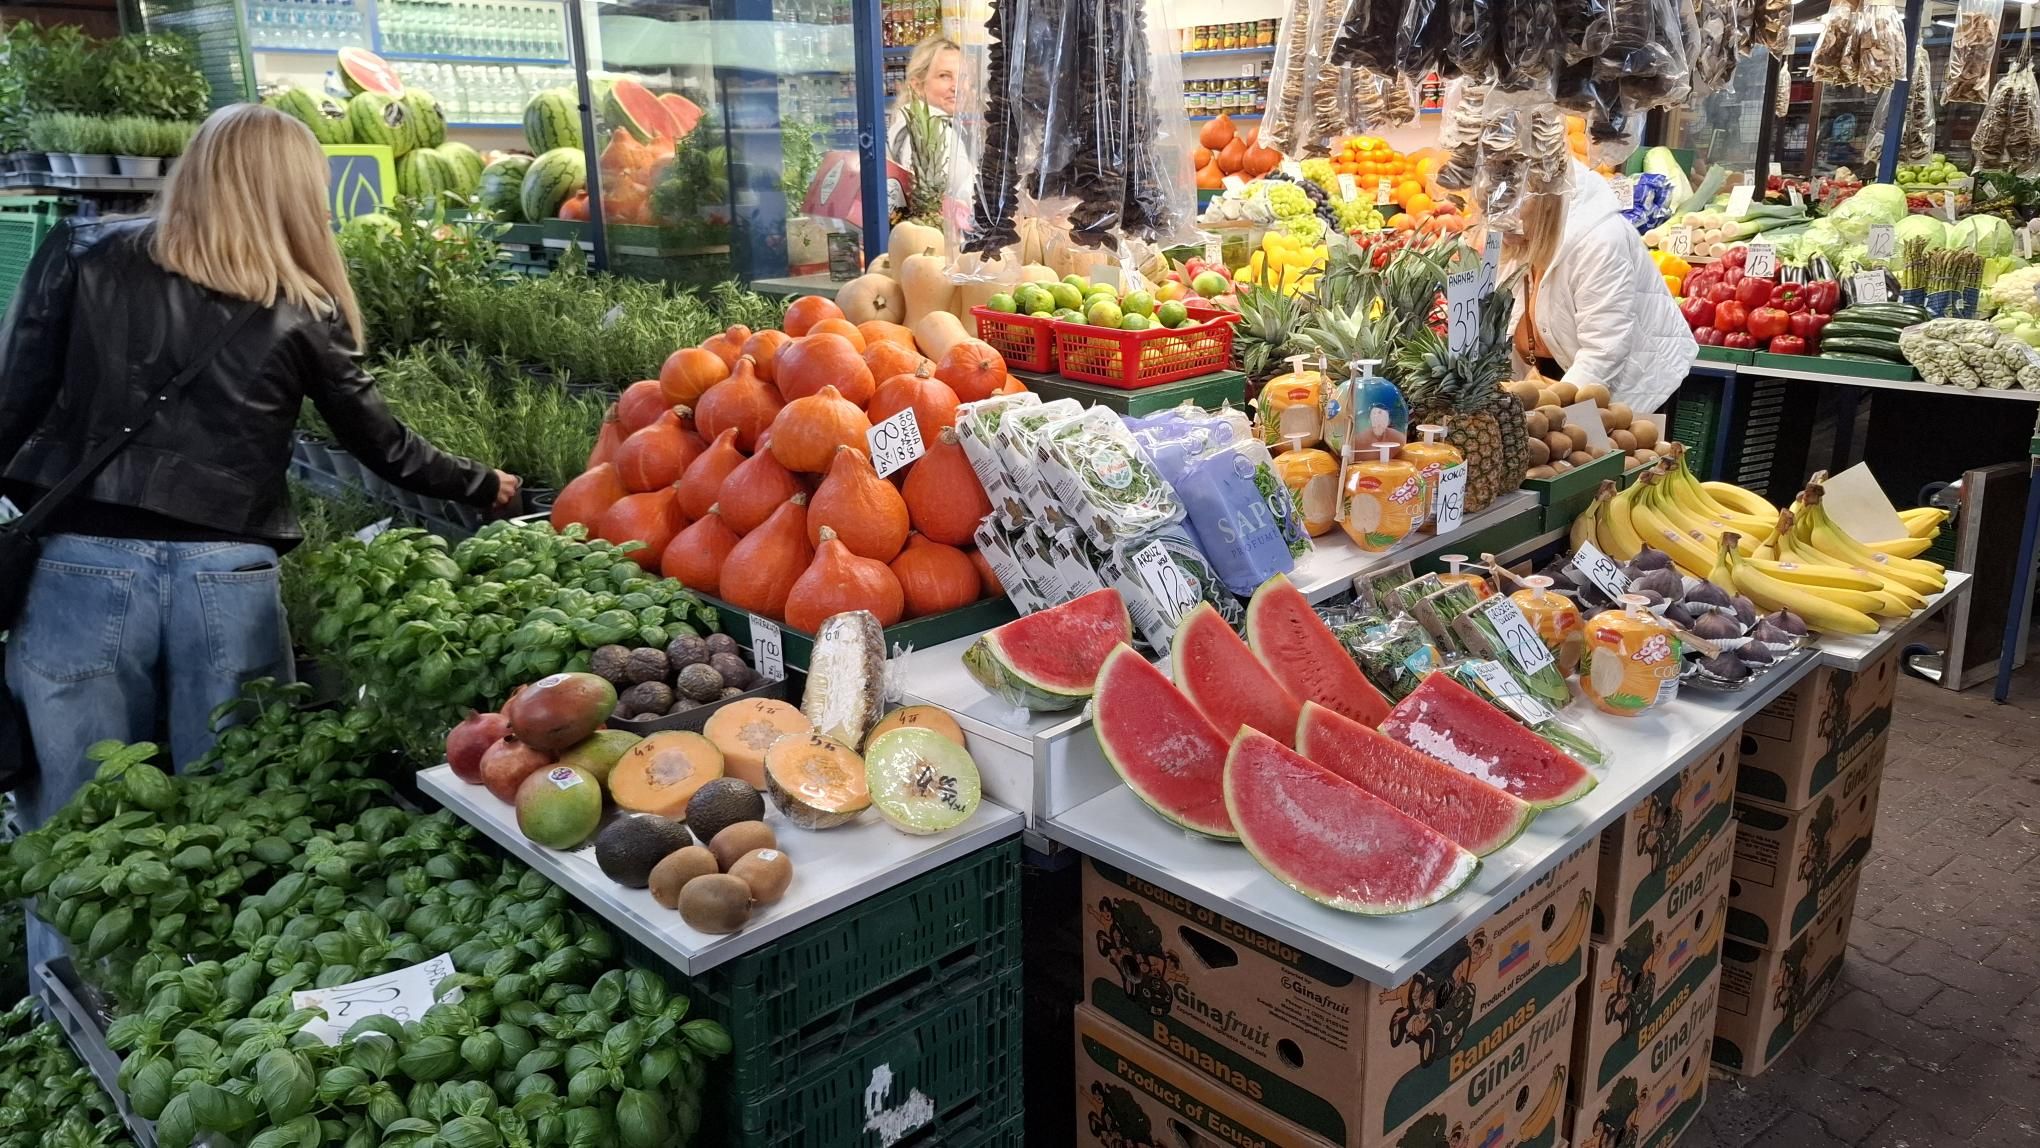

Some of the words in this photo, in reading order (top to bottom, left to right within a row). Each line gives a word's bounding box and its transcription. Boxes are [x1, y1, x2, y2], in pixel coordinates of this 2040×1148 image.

[1748, 255, 1768, 275] 15
[1870, 233, 1889, 256] 12
[1448, 271, 1474, 287] ANANAS
[1451, 298, 1477, 352] 35
[874, 421, 900, 451] 8
[907, 411, 921, 445] DYNIA
[1389, 476, 1415, 501] COCO
[1397, 485, 1419, 505] PRO
[1438, 492, 1459, 523] 18
[1137, 546, 1162, 567] ARBUZ
[1156, 565, 1186, 620] 12
[1507, 624, 1544, 667] 20
[1631, 634, 1666, 660] COCO
[1644, 645, 1671, 665] PRO
[1837, 728, 1875, 772] Bananas
[1666, 830, 1713, 885] Bananas
[1667, 838, 1732, 920] Ginafruit
[1126, 874, 1193, 916] Product
[1194, 906, 1215, 926] of
[1220, 914, 1302, 965] Ecuador
[1292, 981, 1351, 1015] Ginafruit
[1480, 987, 1507, 1013] Product
[1515, 959, 1541, 984] Ecuador
[1793, 978, 1832, 1033] Bananas
[1173, 983, 1272, 1050] Ginafruit
[1449, 997, 1537, 1083] Bananas
[1638, 983, 1690, 1051] Bananas
[1650, 985, 1715, 1074] Ginafruit
[1153, 1020, 1265, 1100] Bananas
[1468, 995, 1572, 1107] Ginafruit
[1117, 1059, 1182, 1109] Product
[1186, 1103, 1203, 1122] of
